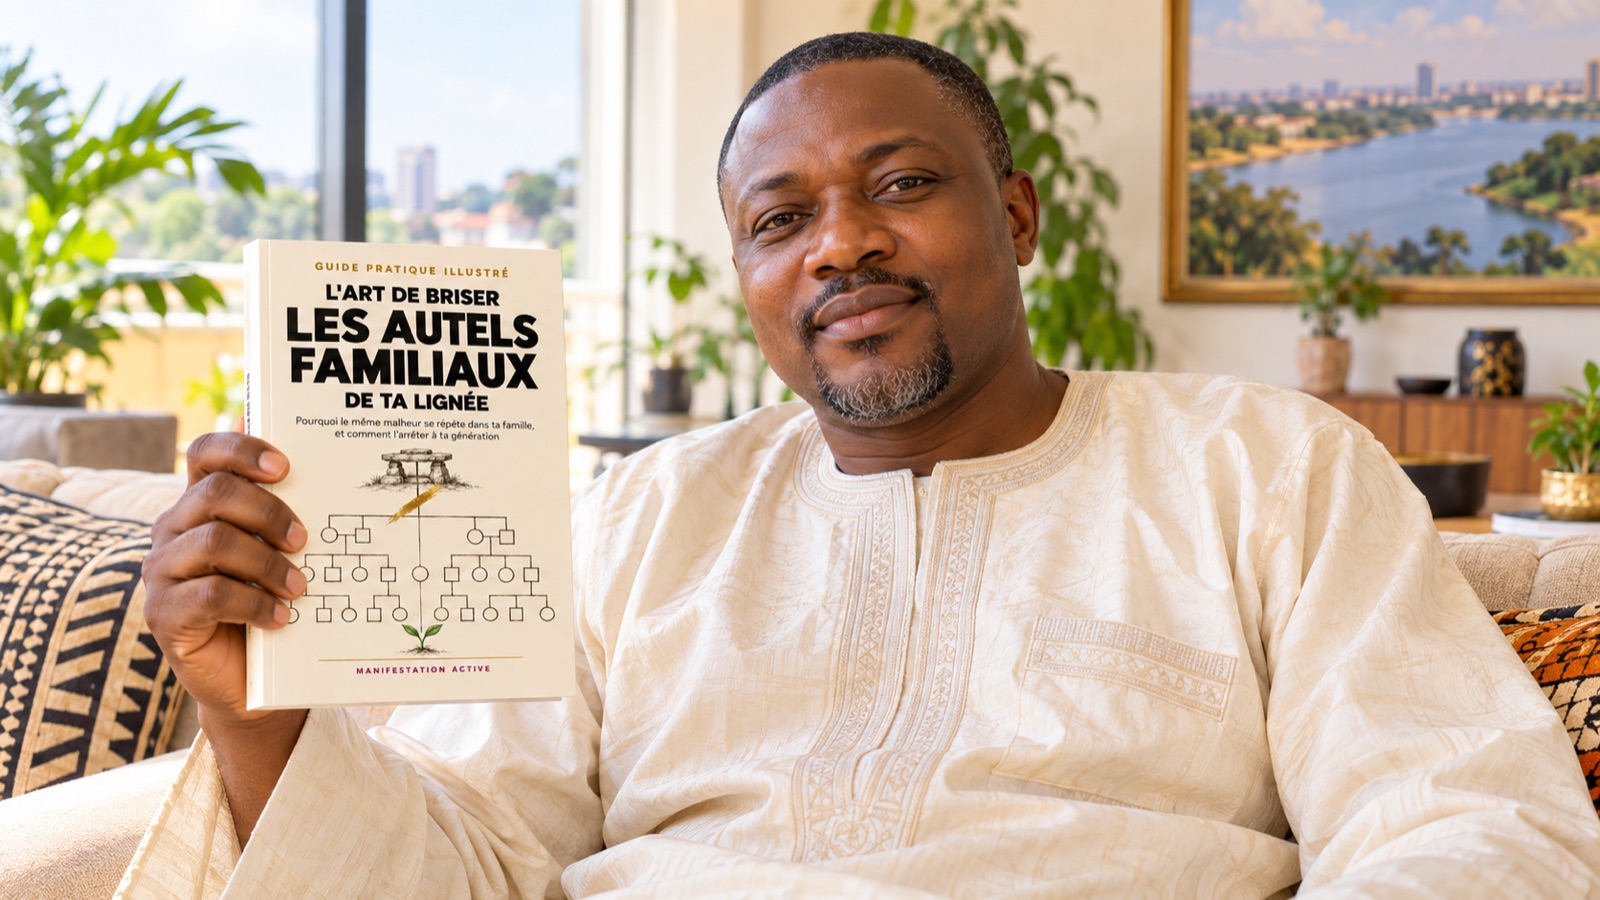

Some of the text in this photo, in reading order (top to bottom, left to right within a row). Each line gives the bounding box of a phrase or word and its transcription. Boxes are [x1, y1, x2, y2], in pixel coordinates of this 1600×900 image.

[314, 261, 509, 279] GUIDE PRATIQUE ILLUSTRÉ
[325, 284, 500, 306] L'ART DE BRISER
[286, 306, 539, 350] LES AUTELS
[290, 345, 539, 390] FAMILIAUX
[344, 391, 490, 411] DE TA LIGNÉE
[295, 416, 339, 427] Pourquoi
[340, 417, 349, 426] le
[383, 418, 422, 428] malheur
[424, 420, 435, 428] se
[467, 420, 490, 429] dans
[491, 421, 501, 429] ta
[502, 420, 536, 431] famille,
[334, 430, 345, 438] et
[346, 430, 392, 439] comment
[439, 431, 449, 440] ta
[450, 430, 500, 442] génération
[356, 665, 491, 675] MANIFESTATION ACTIVE
